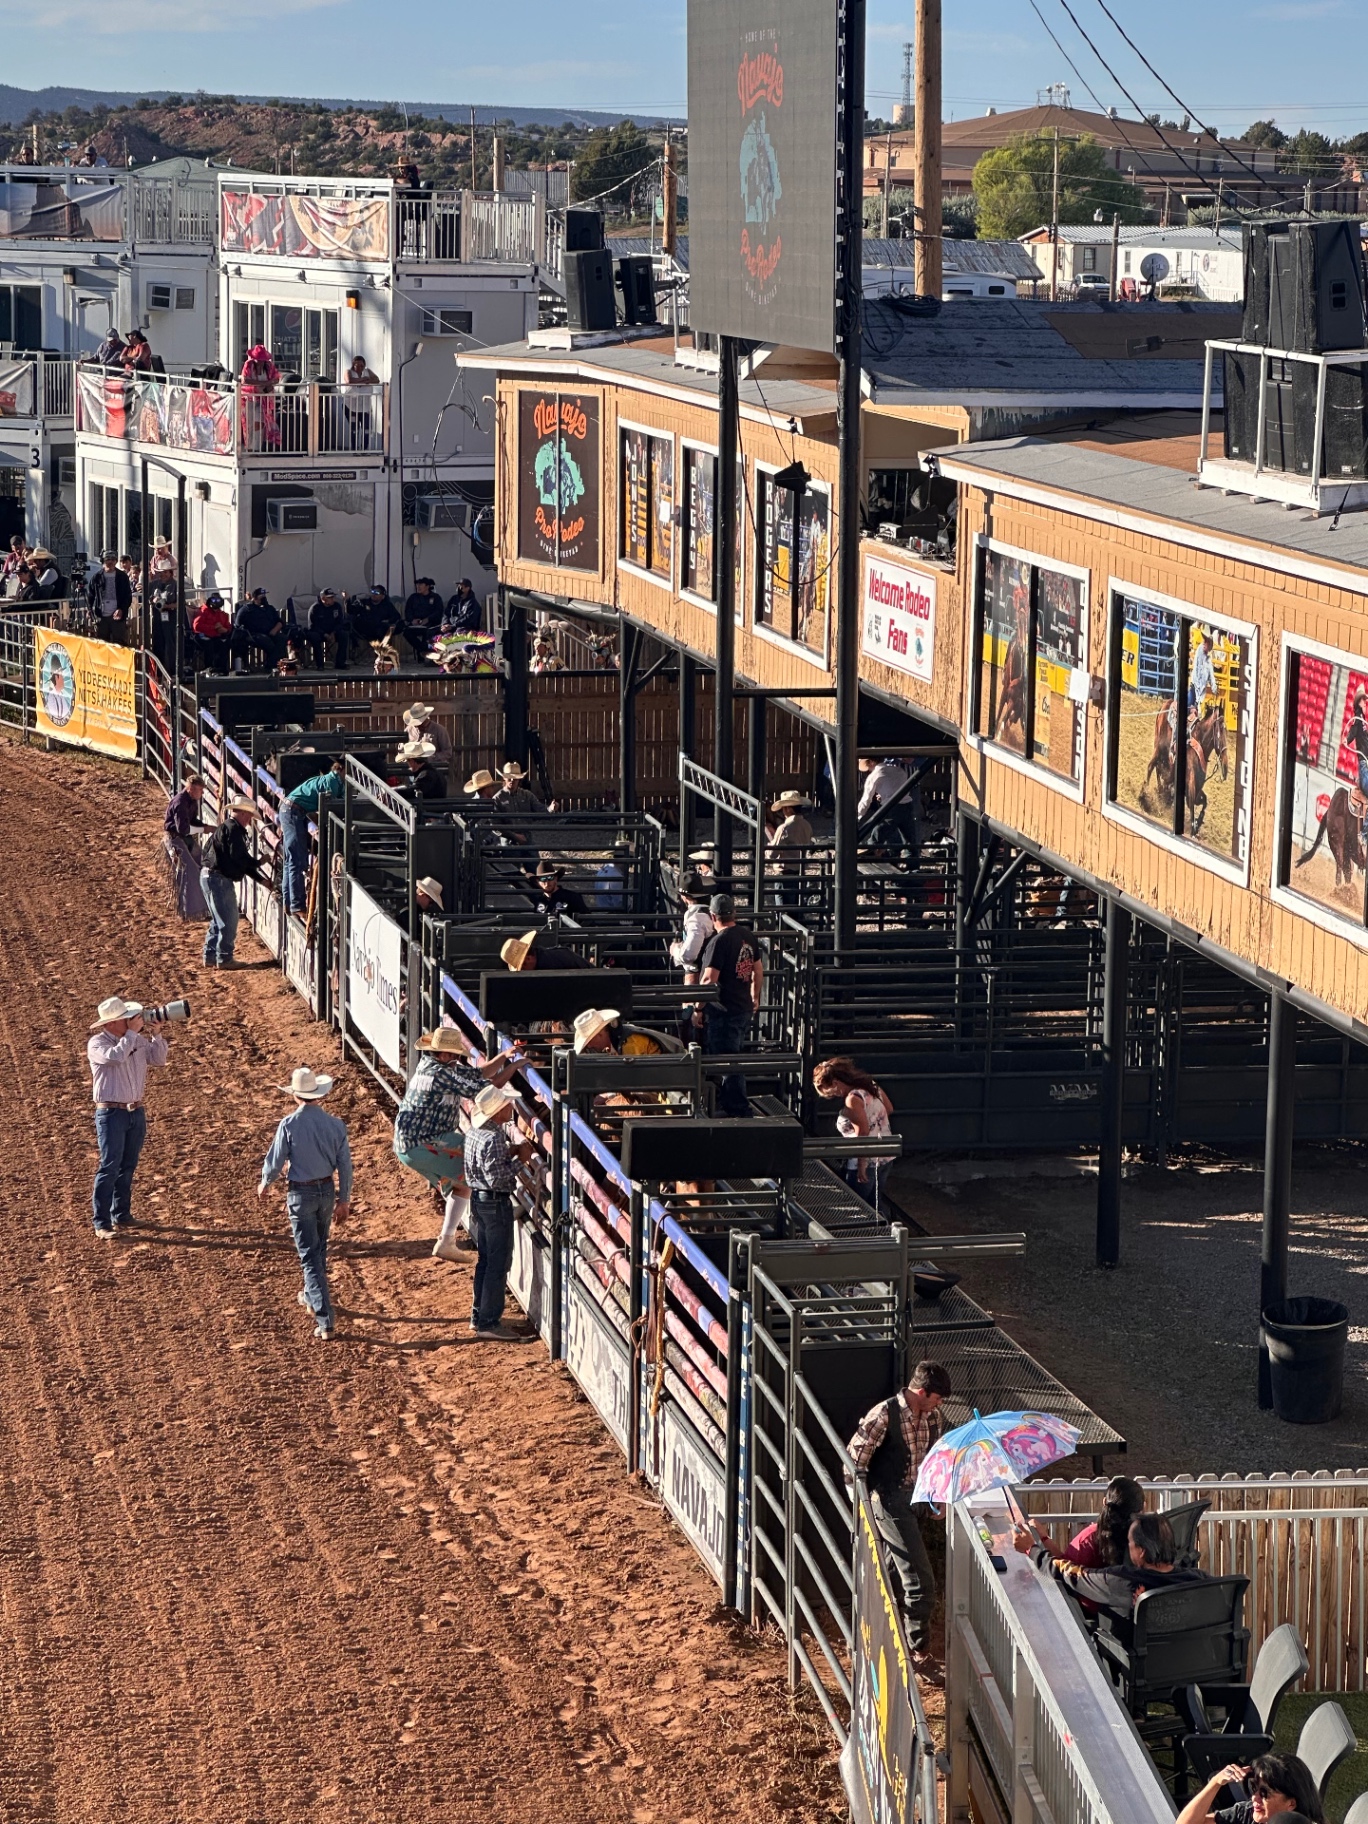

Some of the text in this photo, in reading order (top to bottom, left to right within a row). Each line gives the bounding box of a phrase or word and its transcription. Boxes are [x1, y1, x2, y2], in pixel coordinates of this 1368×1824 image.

[738, 42, 783, 118] Navajo
[534, 398, 587, 439] Navajo
[31, 447, 41, 469] 3
[764, 480, 773, 614] ROGERS
[869, 568, 930, 621] Welcome Rodeo
[887, 618, 908, 655] Fans
[376, 955, 397, 1016] Times
[672, 1448, 725, 1566] NAVAJO
